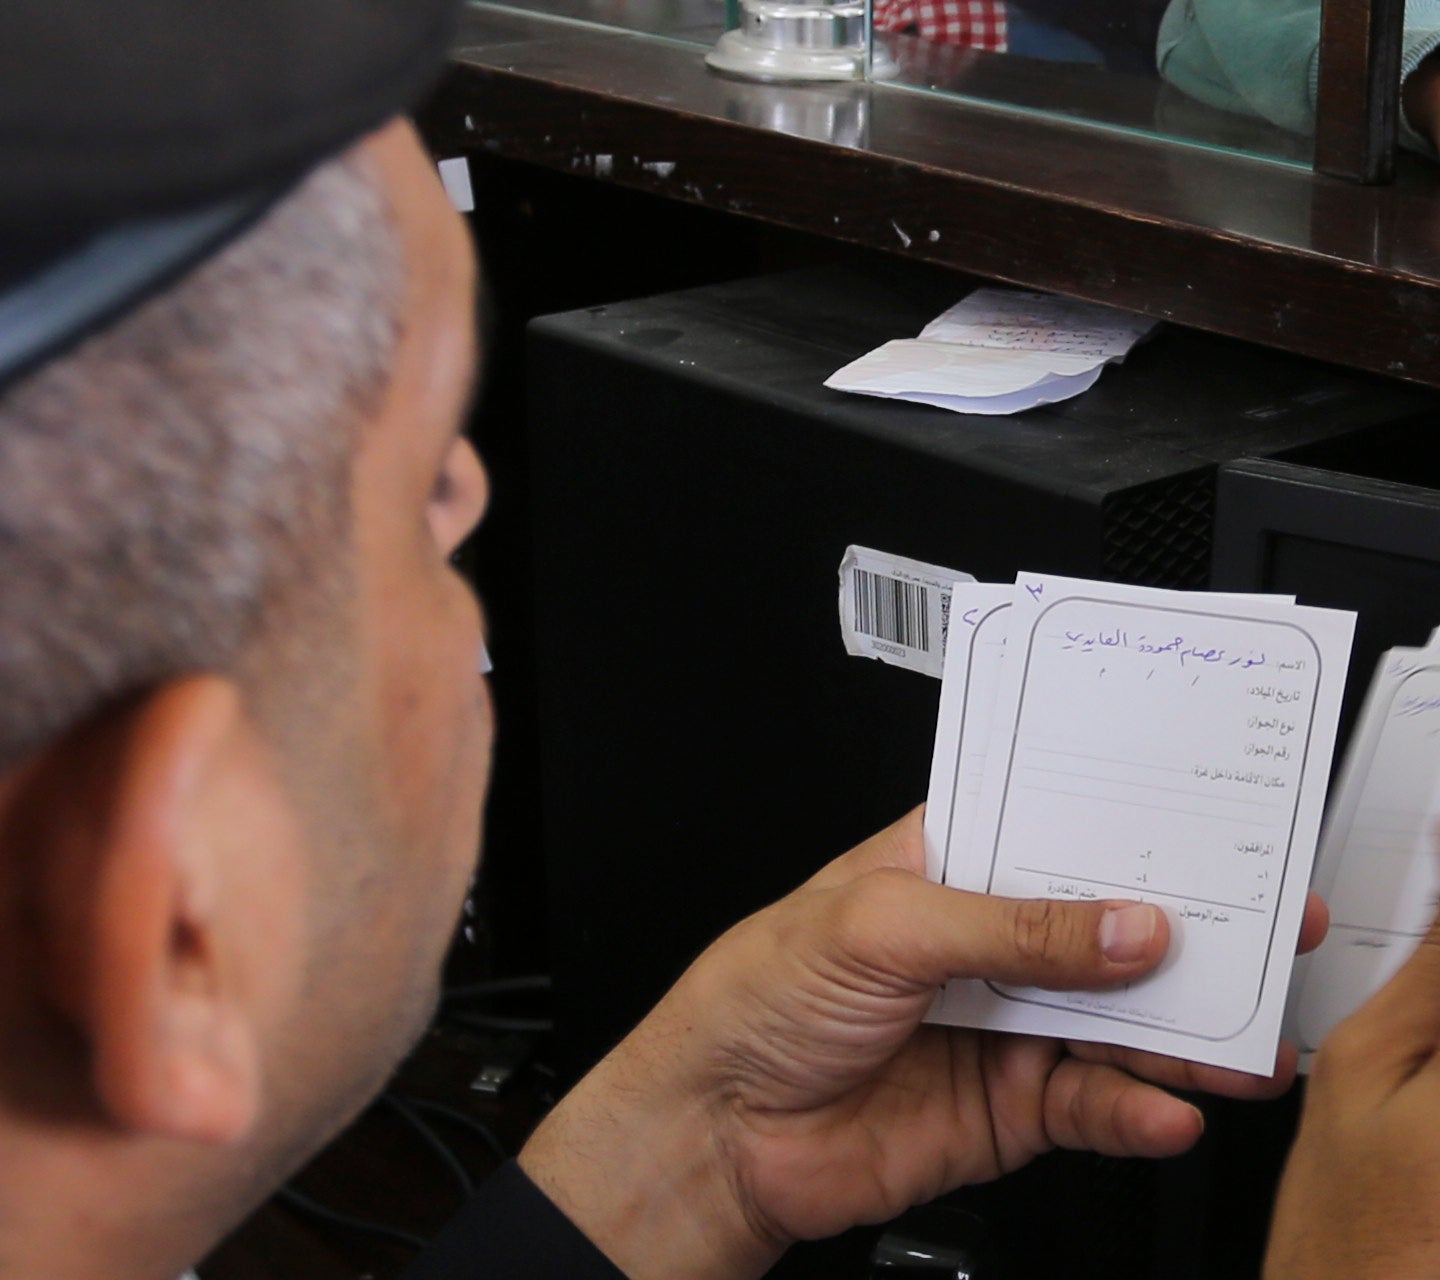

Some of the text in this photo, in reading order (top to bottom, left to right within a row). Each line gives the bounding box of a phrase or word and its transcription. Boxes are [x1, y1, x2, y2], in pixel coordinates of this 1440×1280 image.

[1246, 685, 1275, 699] الميلاد:
[1275, 690, 1301, 703] تاريخ
[1279, 724, 1296, 735] نوع
[1274, 749, 1291, 761] رقم
